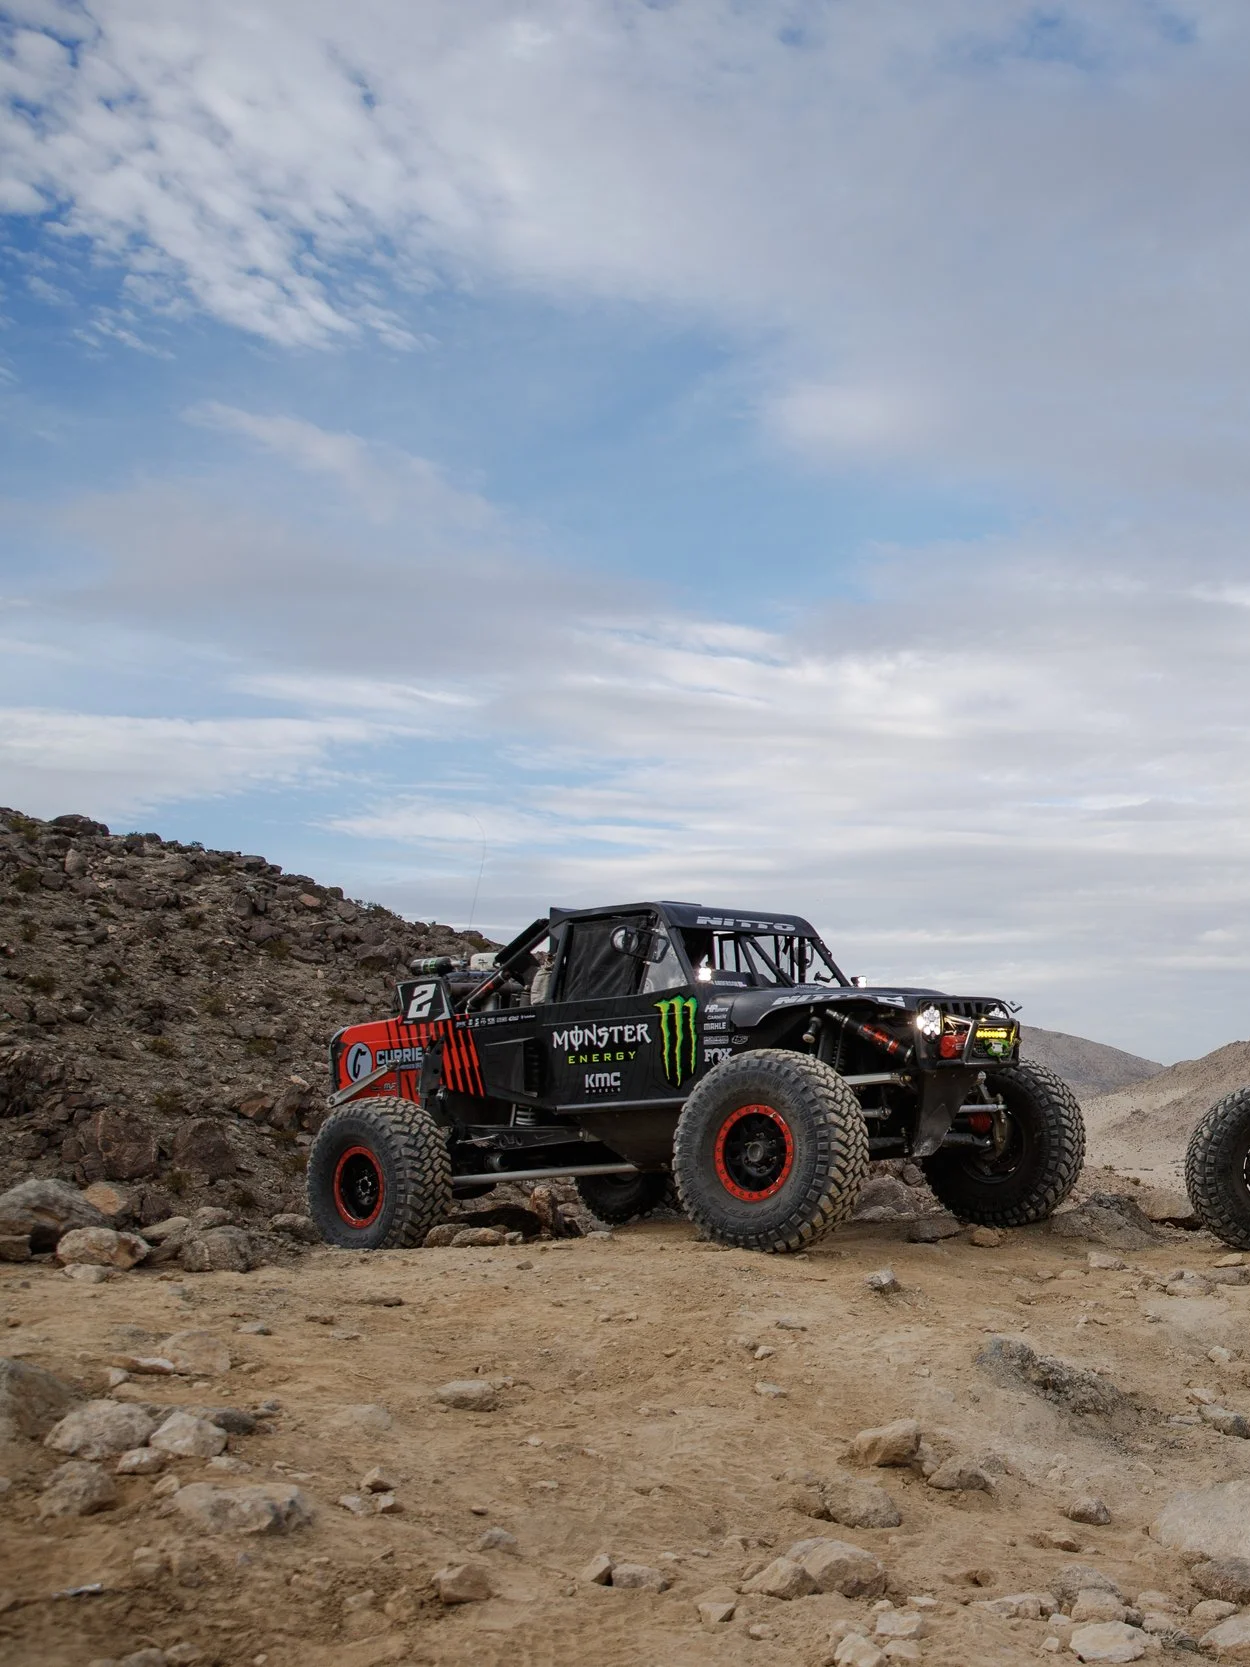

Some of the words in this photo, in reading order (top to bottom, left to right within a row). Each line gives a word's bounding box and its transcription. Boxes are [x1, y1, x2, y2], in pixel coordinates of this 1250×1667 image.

[696, 915, 796, 932] NITTO
[407, 983, 437, 1019] 2
[552, 1023, 652, 1051] MONSTER
[568, 1051, 636, 1065] ENERGY
